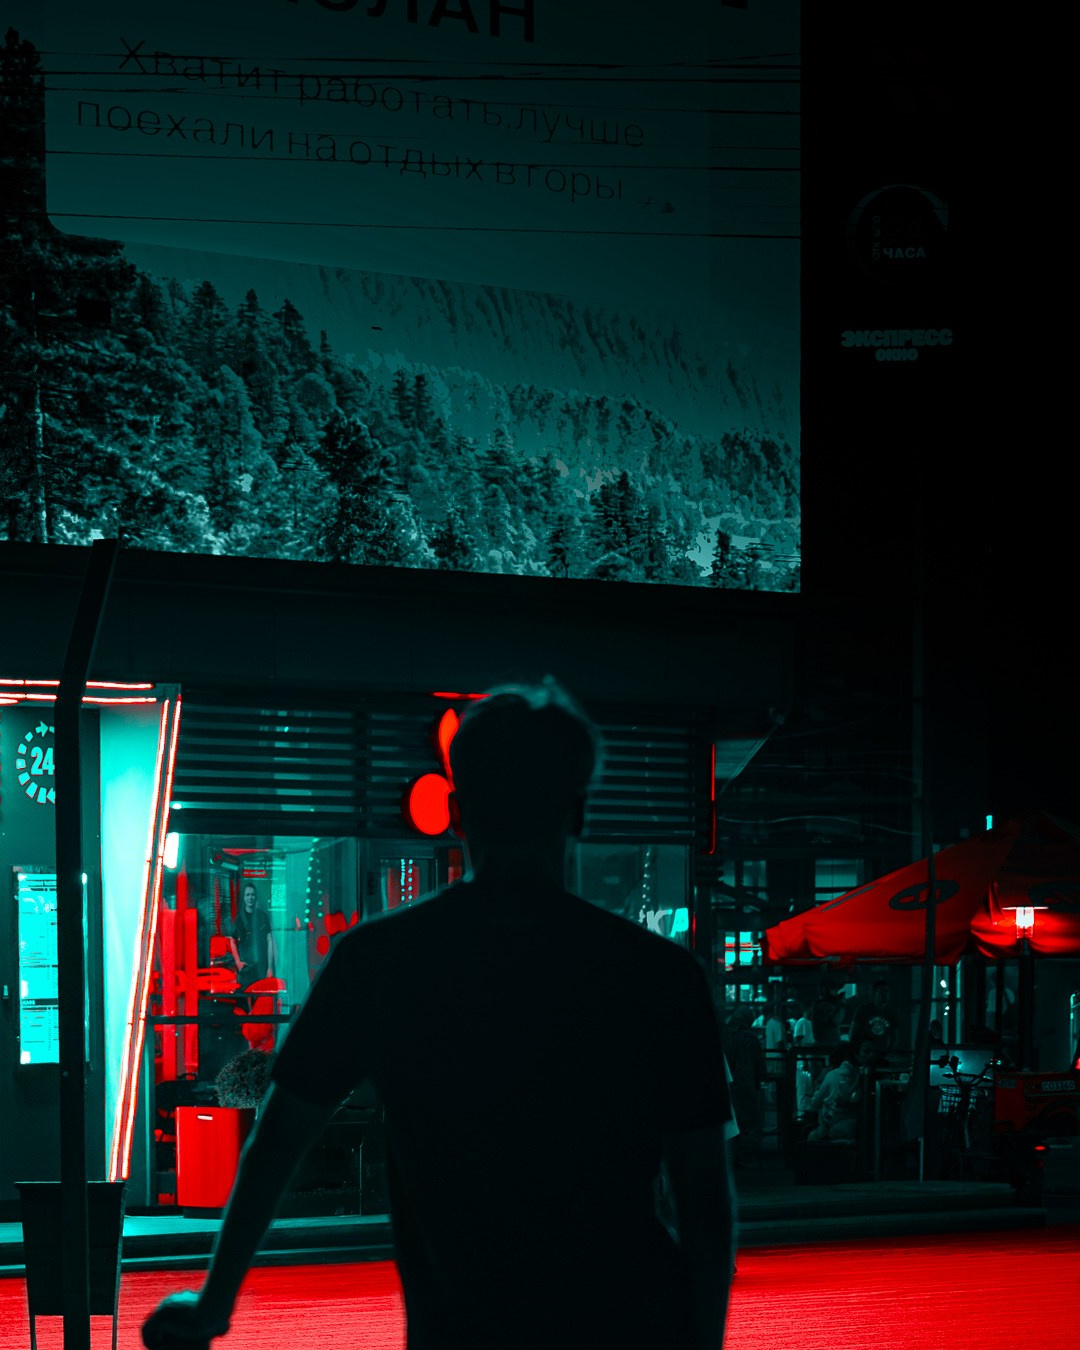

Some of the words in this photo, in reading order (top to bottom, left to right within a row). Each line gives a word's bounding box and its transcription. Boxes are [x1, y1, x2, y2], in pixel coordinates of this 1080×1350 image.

[118, 36, 285, 93] Хватит
[514, 107, 646, 147] лучше
[77, 100, 274, 152] поехали
[288, 132, 337, 162] на
[348, 141, 484, 183] отдых
[496, 161, 517, 185] в
[527, 163, 623, 205] горы
[882, 246, 927, 260] ЧАСА
[840, 328, 954, 348] ЭКСПРЕСС
